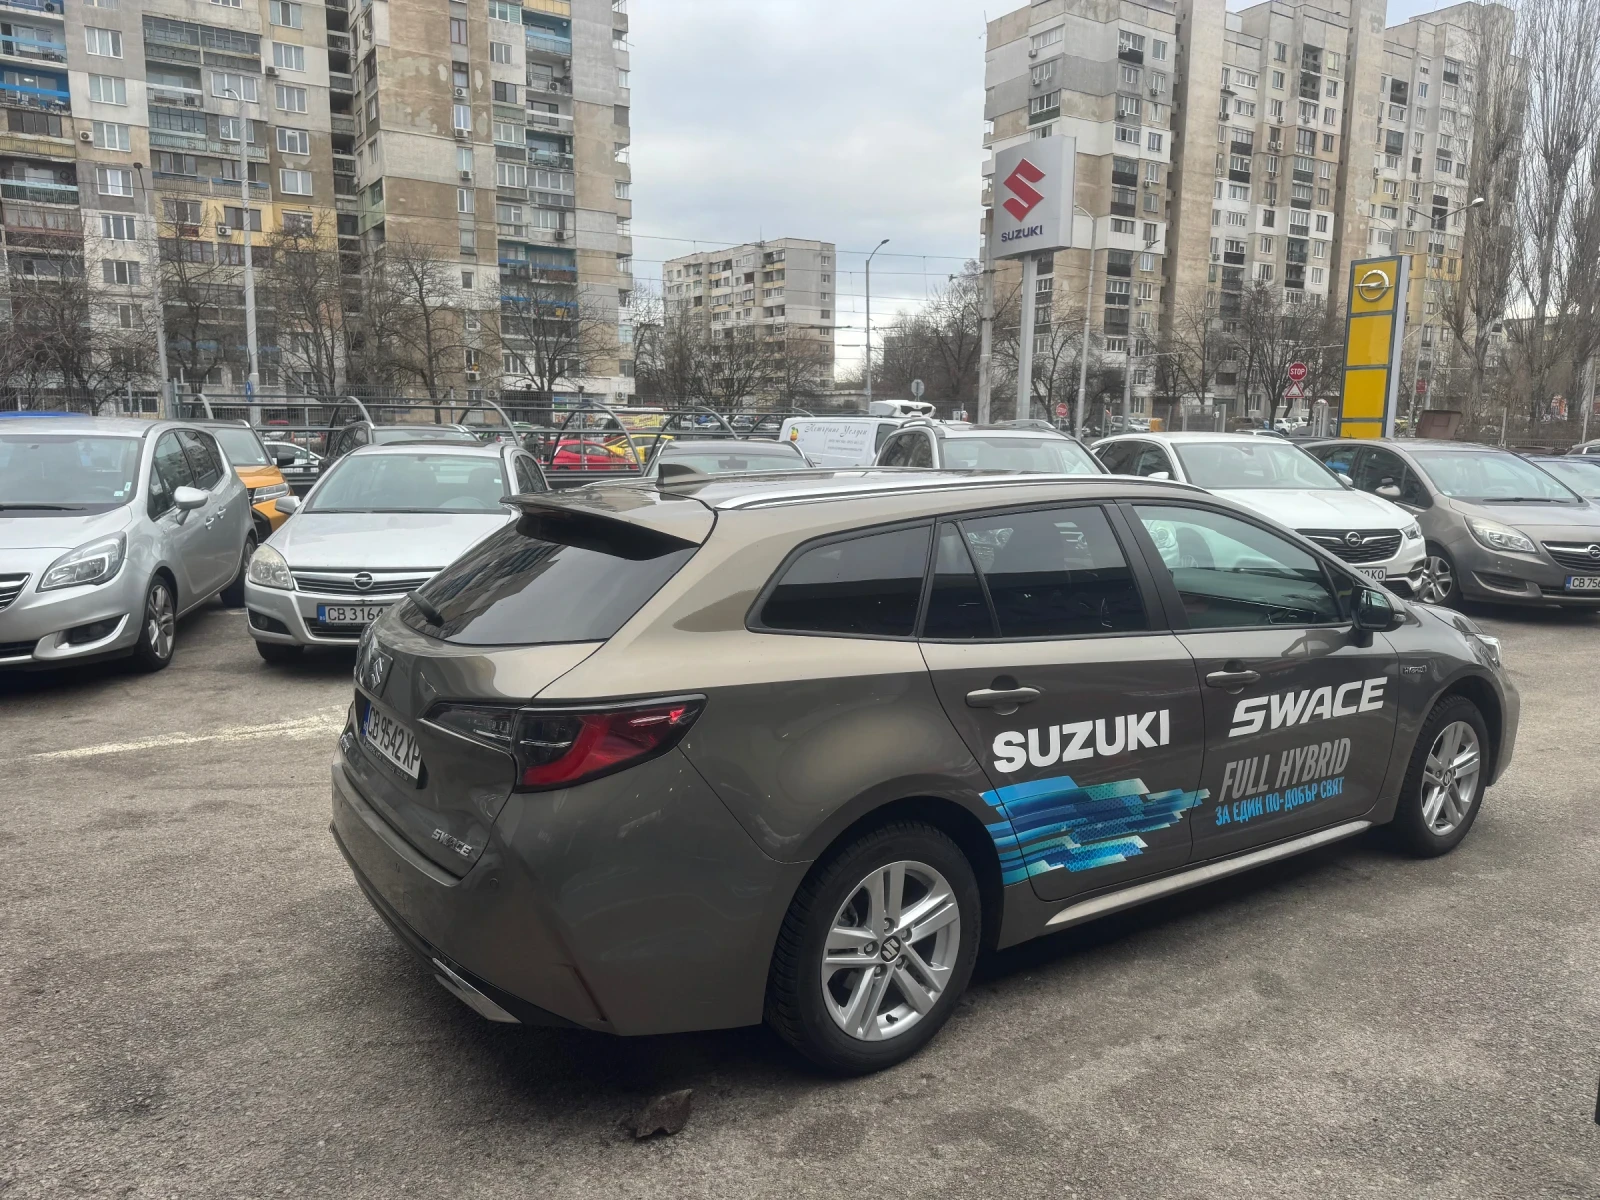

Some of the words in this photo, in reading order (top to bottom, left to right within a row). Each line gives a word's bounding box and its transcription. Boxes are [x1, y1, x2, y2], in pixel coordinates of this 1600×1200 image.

[1001, 225, 1043, 242] SUZUKI
[1572, 577, 1585, 588] CB
[327, 607, 347, 621] CB
[1228, 676, 1388, 738] SWACE
[368, 706, 380, 740] CB
[380, 716, 405, 762] 9542
[402, 732, 421, 771] XP
[992, 709, 1170, 773] SUZUKI
[1218, 754, 1271, 803] FULL
[1274, 737, 1351, 789] HYBRID
[1215, 804, 1231, 826] ЗА
[1232, 795, 1264, 824] ЕДИН
[1265, 782, 1318, 813] ПО-ДОБЪР
[1320, 776, 1345, 799] СВЯТ
[431, 828, 472, 857] SWACE
